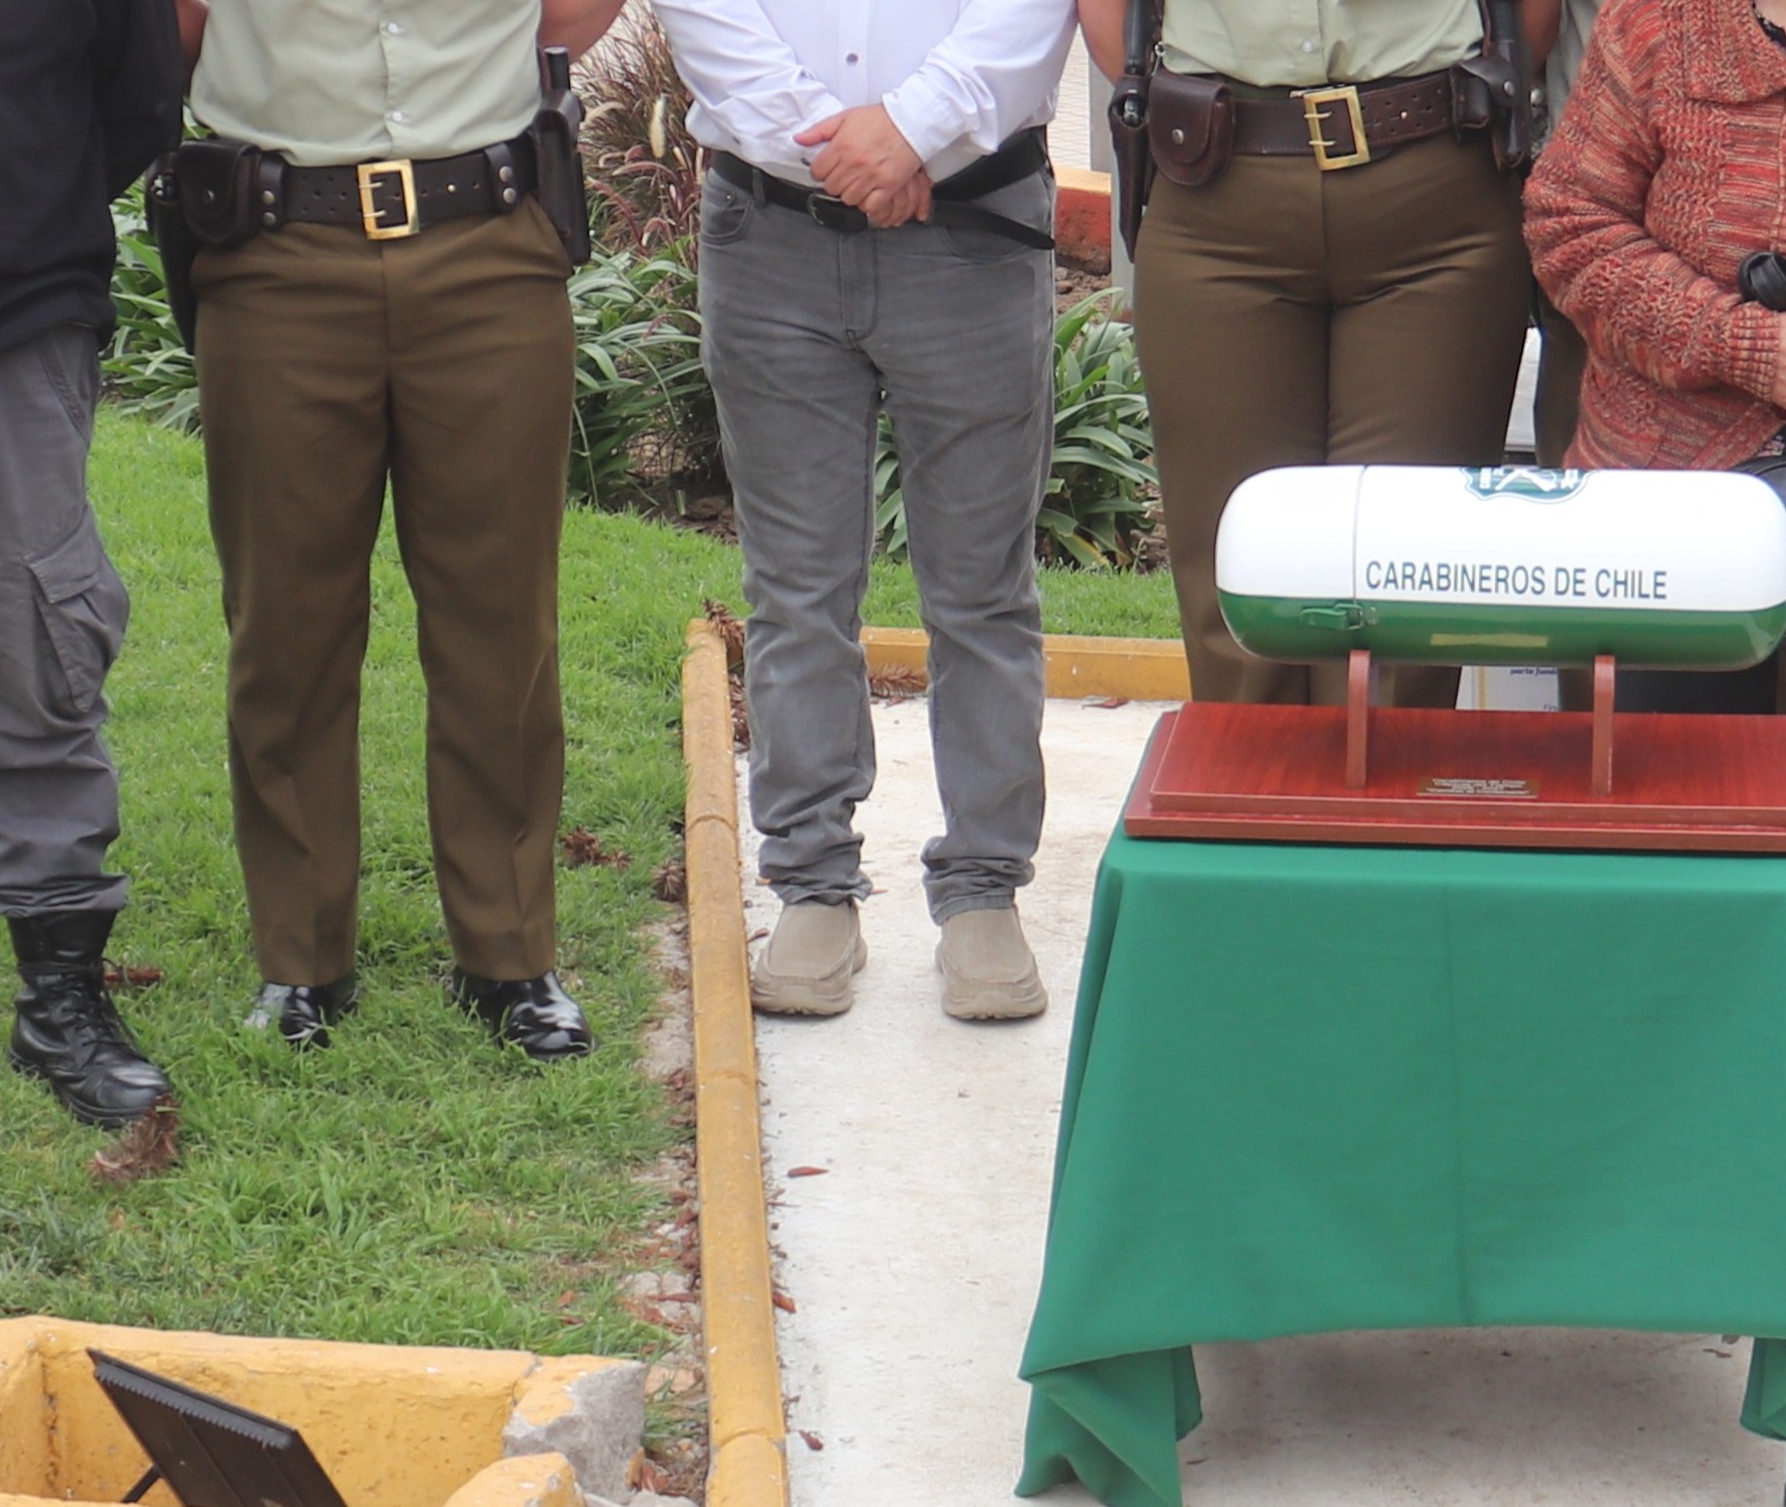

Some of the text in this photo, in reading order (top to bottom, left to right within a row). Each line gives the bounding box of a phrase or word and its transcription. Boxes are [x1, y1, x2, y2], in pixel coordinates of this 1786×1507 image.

[1365, 560, 1667, 599] CARABINEROS DE CHILE
